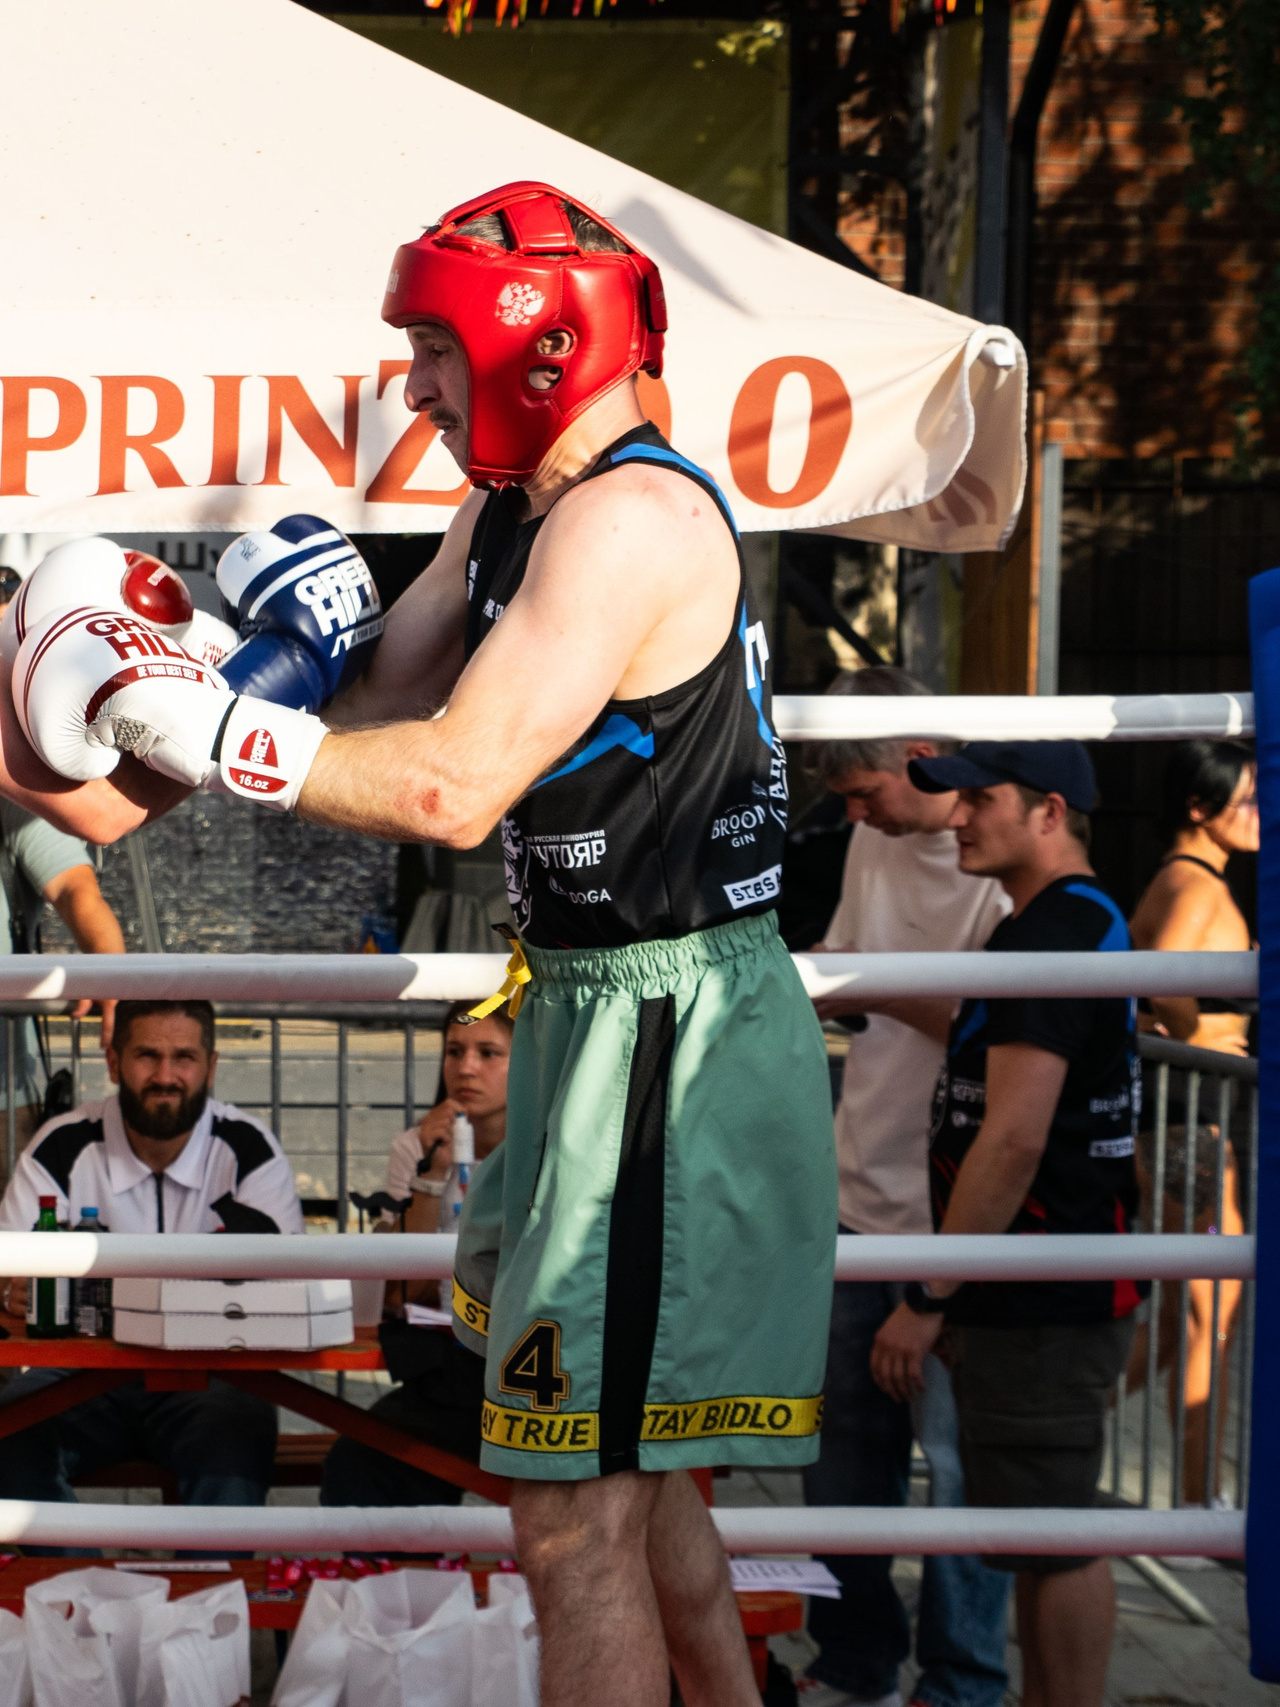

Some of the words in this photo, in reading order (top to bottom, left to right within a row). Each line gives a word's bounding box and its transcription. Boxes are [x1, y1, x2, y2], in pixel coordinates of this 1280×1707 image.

[294, 556, 373, 606] GREE
[104, 632, 206, 668] HILL
[136, 666, 149, 678] BE
[147, 664, 167, 677] YOUR
[165, 665, 184, 678] BEST
[182, 668, 198, 680] SELF
[239, 773, 270, 790] 16.oz
[530, 839, 607, 869] УТОЯР
[730, 833, 756, 848] GIN
[568, 888, 612, 905] DOGA
[498, 1318, 571, 1413] 4
[504, 1414, 591, 1447] TRUE
[643, 1408, 698, 1435] TAY
[701, 1401, 793, 1431] BIDLO
